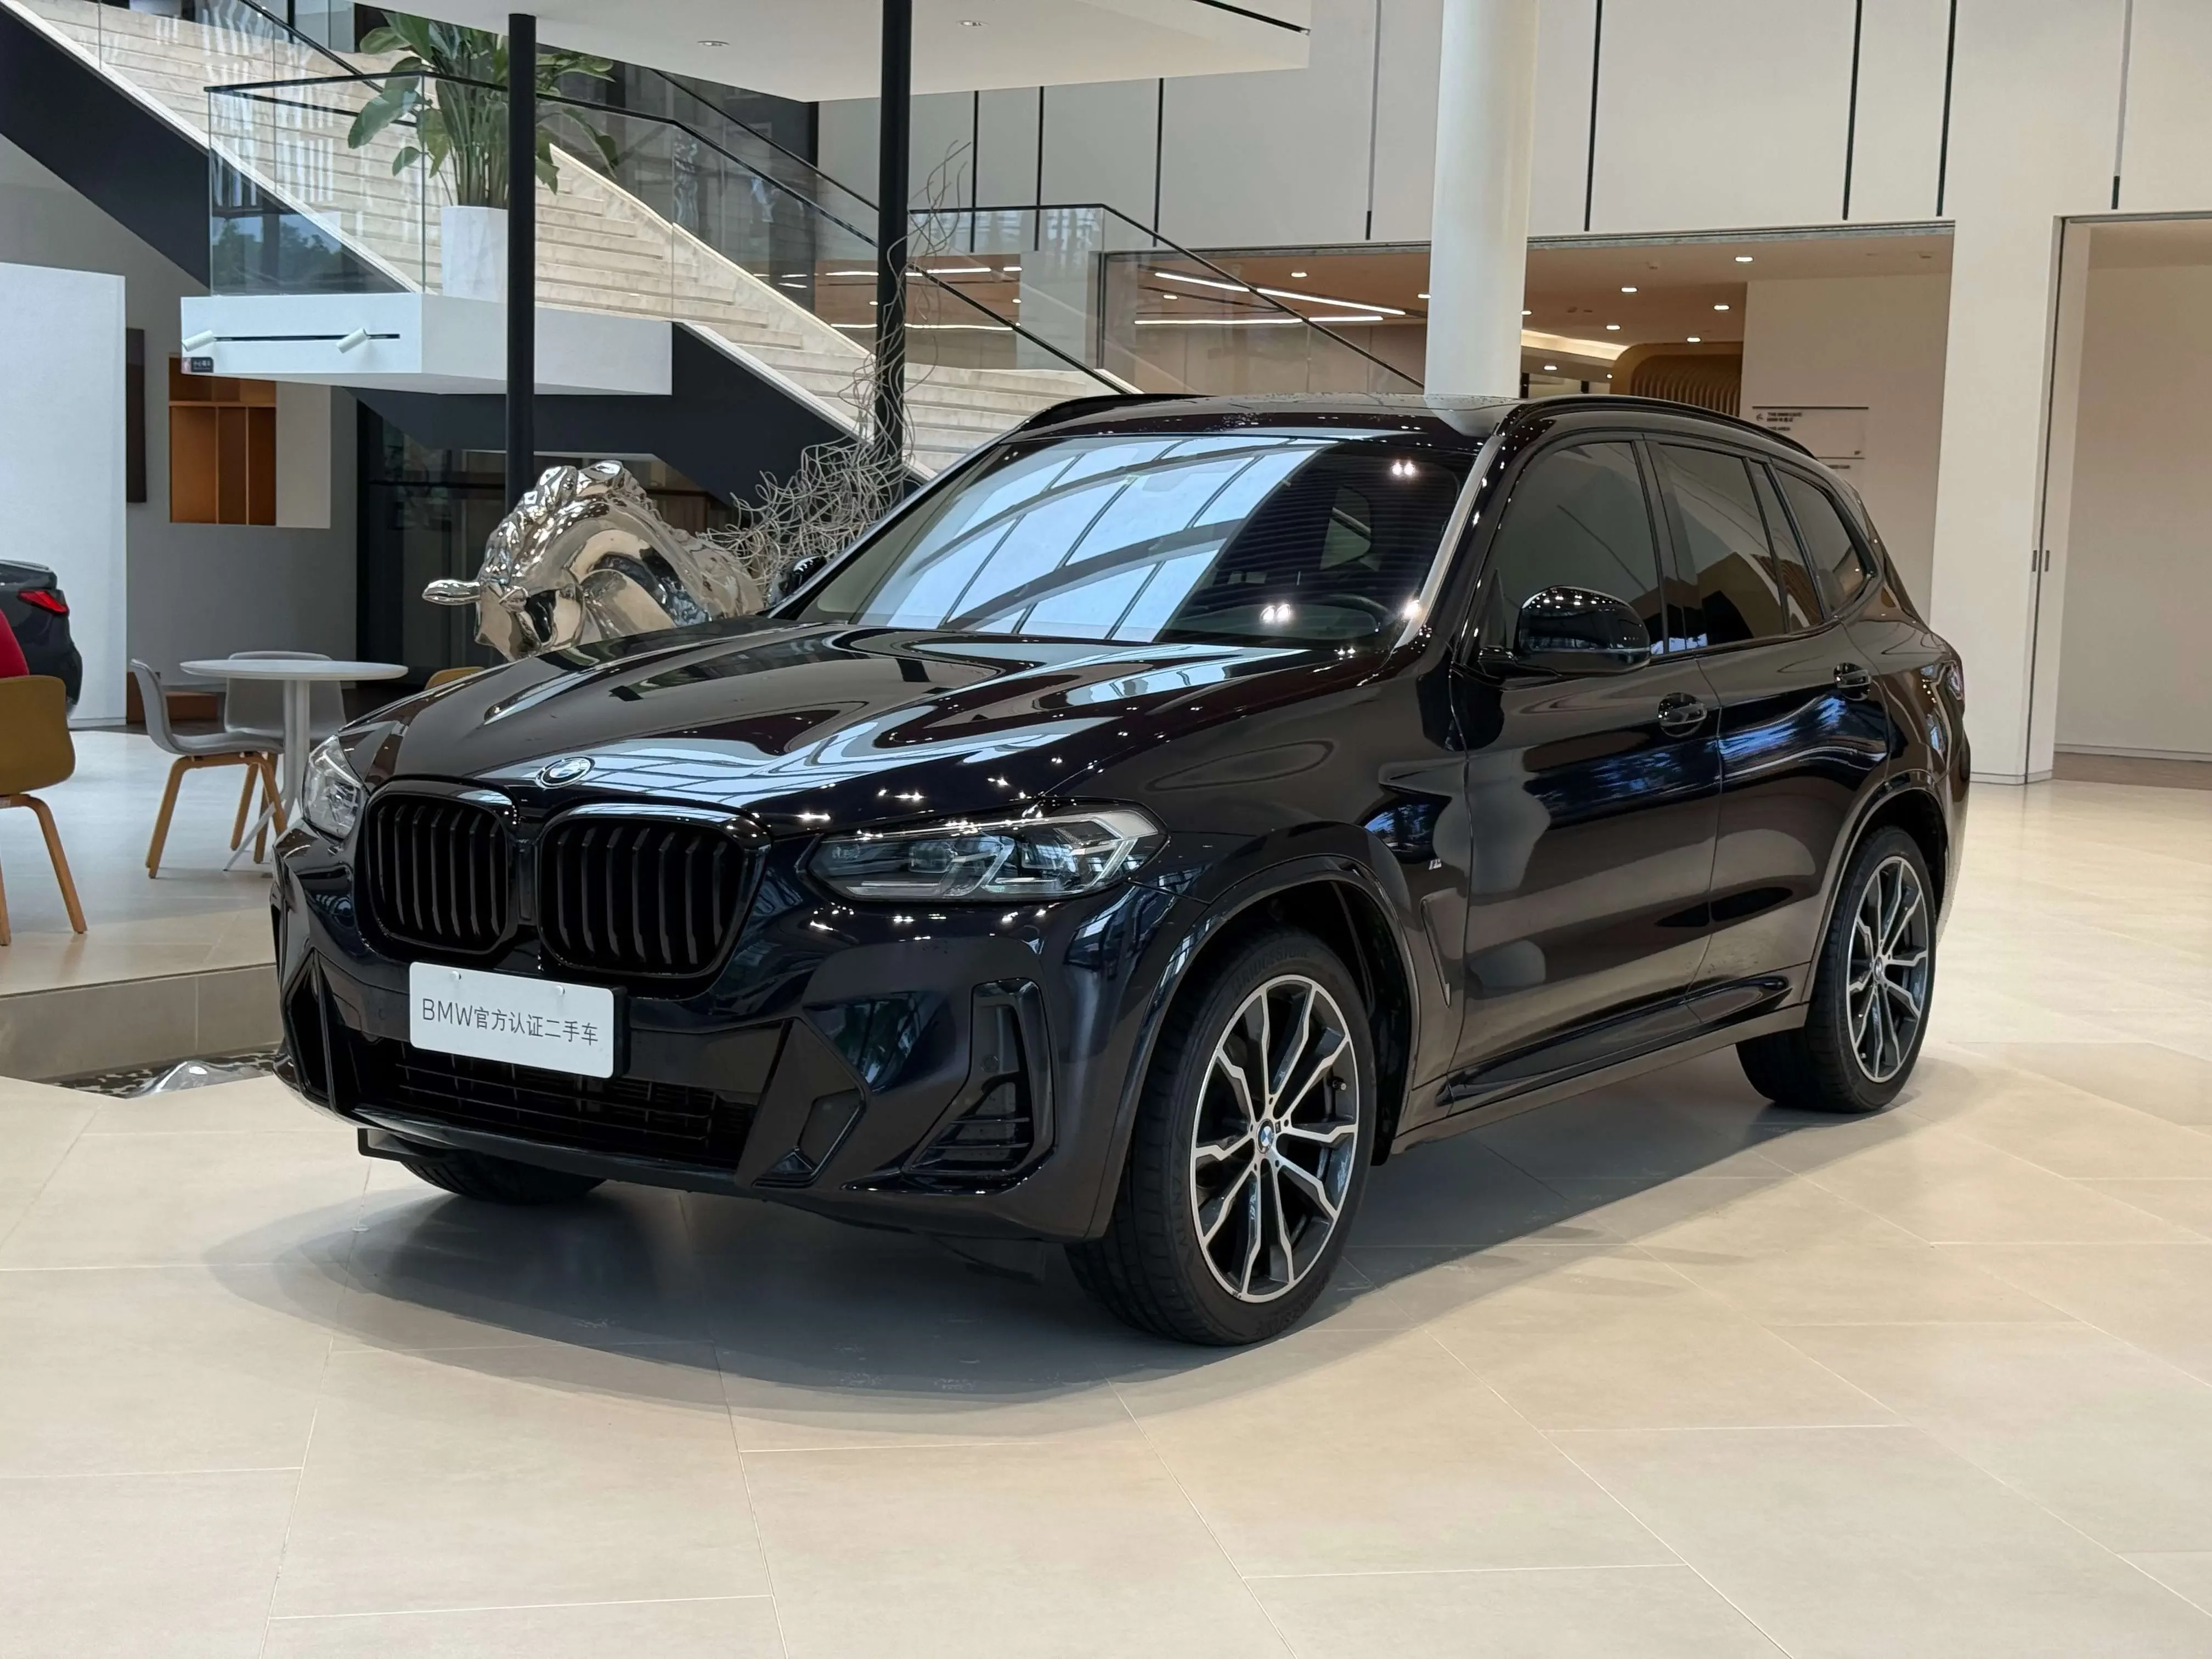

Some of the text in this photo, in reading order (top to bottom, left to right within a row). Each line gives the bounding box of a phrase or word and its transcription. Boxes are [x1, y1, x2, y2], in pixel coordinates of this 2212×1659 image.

[422, 998, 599, 1046] BMW官方认证二手车
